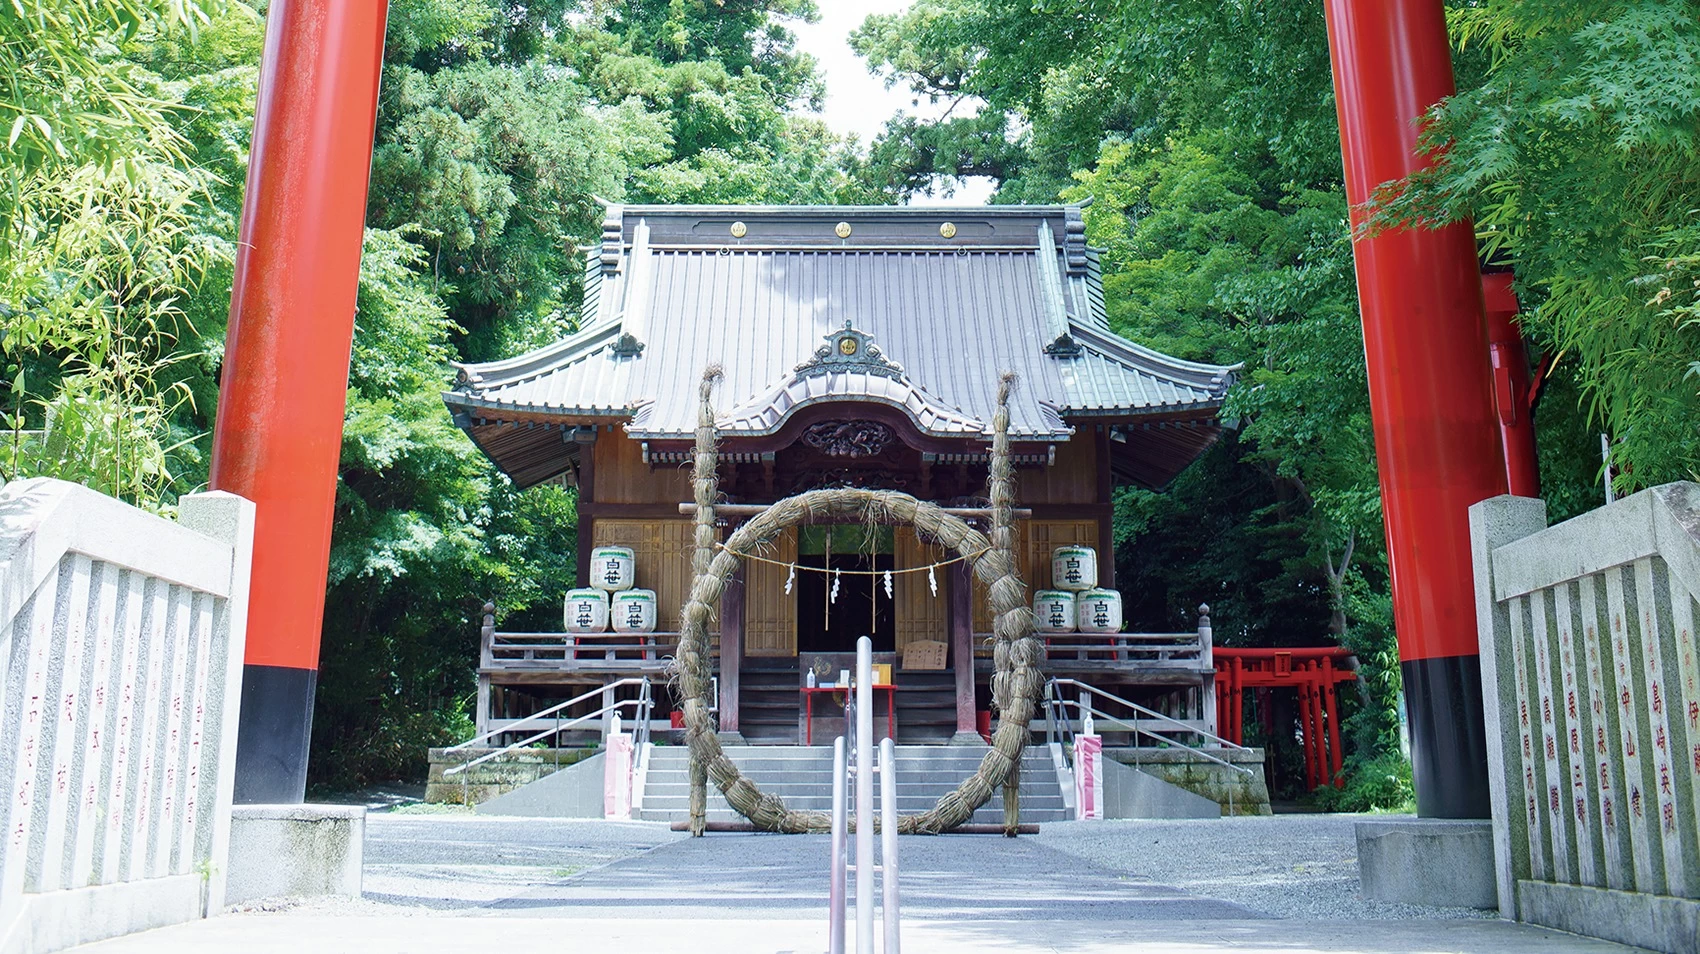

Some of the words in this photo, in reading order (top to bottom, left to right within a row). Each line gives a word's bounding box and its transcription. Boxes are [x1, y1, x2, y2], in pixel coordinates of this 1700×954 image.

[604, 558, 621, 584] 白笹
[1065, 557, 1082, 584] 白笹
[576, 601, 593, 628] 白笹
[626, 601, 643, 628] 白笹
[1049, 601, 1065, 627] 白笹
[1093, 601, 1110, 627] 白笹
[1652, 680, 1675, 832] 島崎英明
